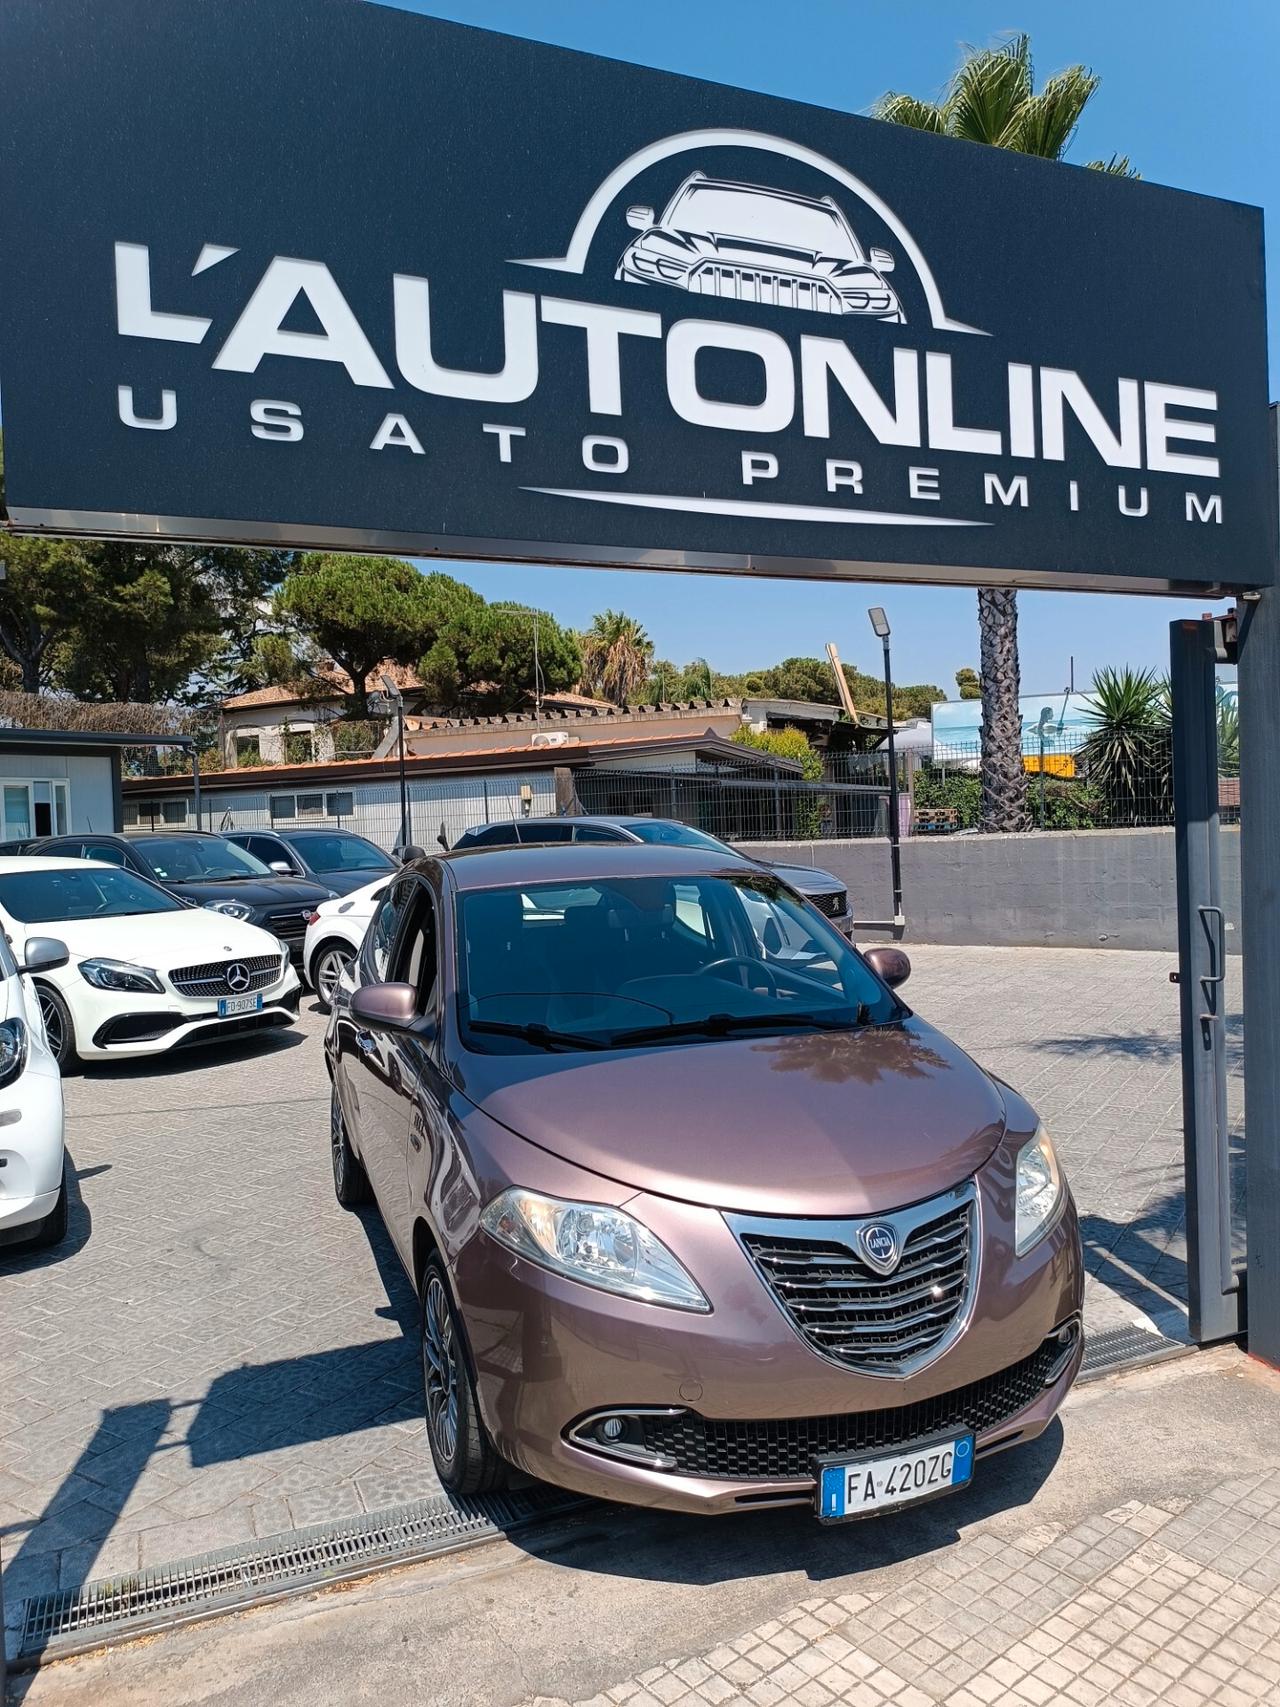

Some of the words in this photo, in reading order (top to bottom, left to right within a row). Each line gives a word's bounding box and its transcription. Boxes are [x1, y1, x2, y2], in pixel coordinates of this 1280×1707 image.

[114, 240, 1221, 478] L'AUTONLINE
[117, 384, 629, 474] USATO
[740, 450, 1224, 524] PREMIUM
[869, 1236, 891, 1249] LANCIA
